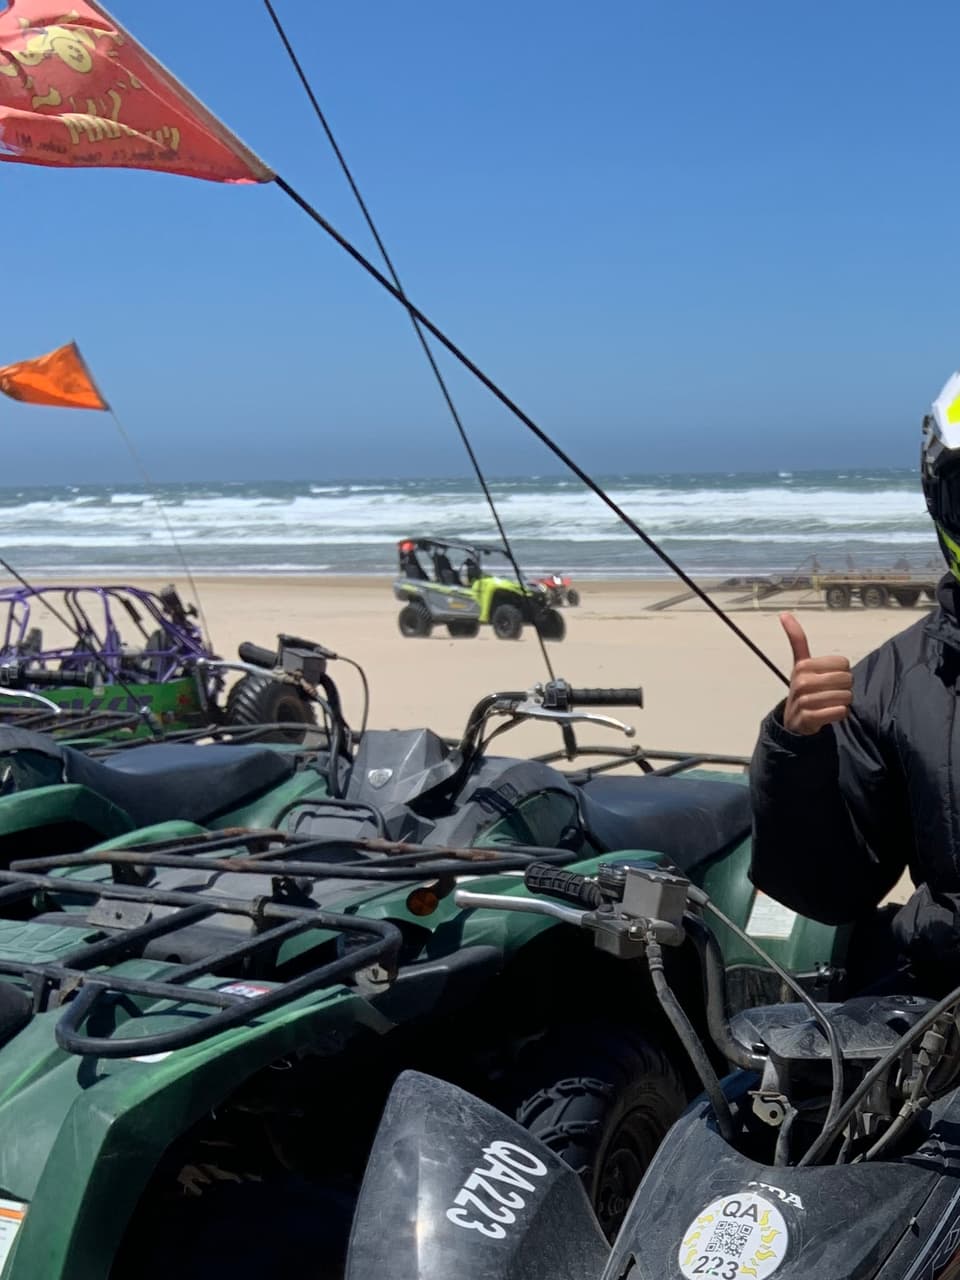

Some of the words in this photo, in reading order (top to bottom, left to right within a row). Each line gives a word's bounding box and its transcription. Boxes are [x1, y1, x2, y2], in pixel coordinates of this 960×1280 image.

[446, 1141, 548, 1239] QA223
[722, 1200, 759, 1223] QA
[692, 1255, 739, 1280] 223
